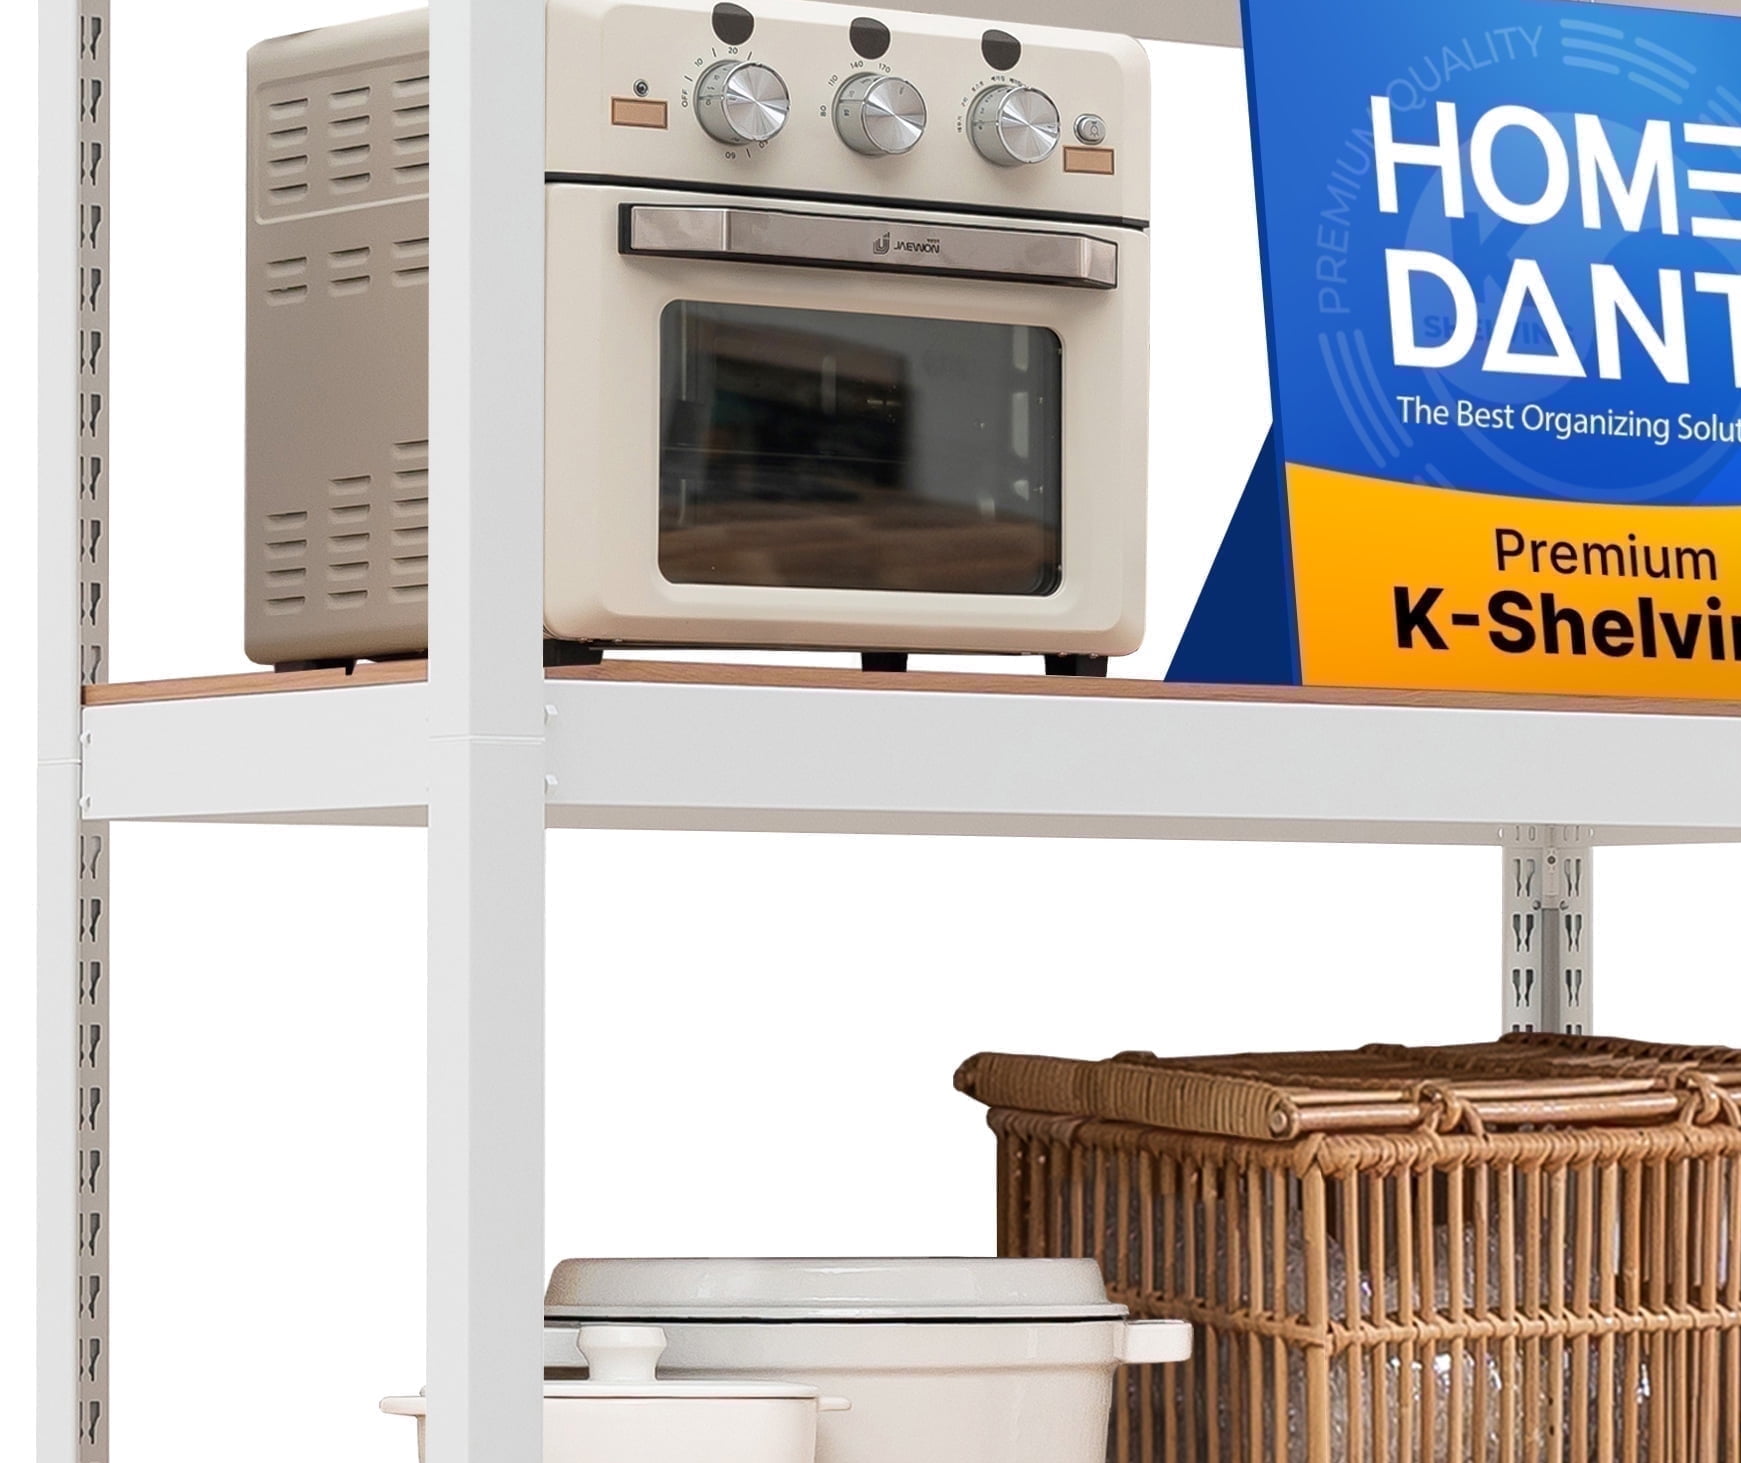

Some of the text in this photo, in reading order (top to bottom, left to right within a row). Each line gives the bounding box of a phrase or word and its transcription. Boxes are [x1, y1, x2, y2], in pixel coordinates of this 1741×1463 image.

[728, 46, 738, 55] 20
[694, 57, 704, 68] 10
[849, 60, 864, 70] 140
[878, 62, 891, 74] 170
[1385, 24, 1543, 112] QUALITY
[827, 74, 839, 87] 110
[681, 88, 689, 108] OFF
[1396, 395, 1450, 425] The
[1456, 399, 1515, 430] Best
[1521, 403, 1670, 446] Organizing
[1495, 527, 1718, 581] Premium
